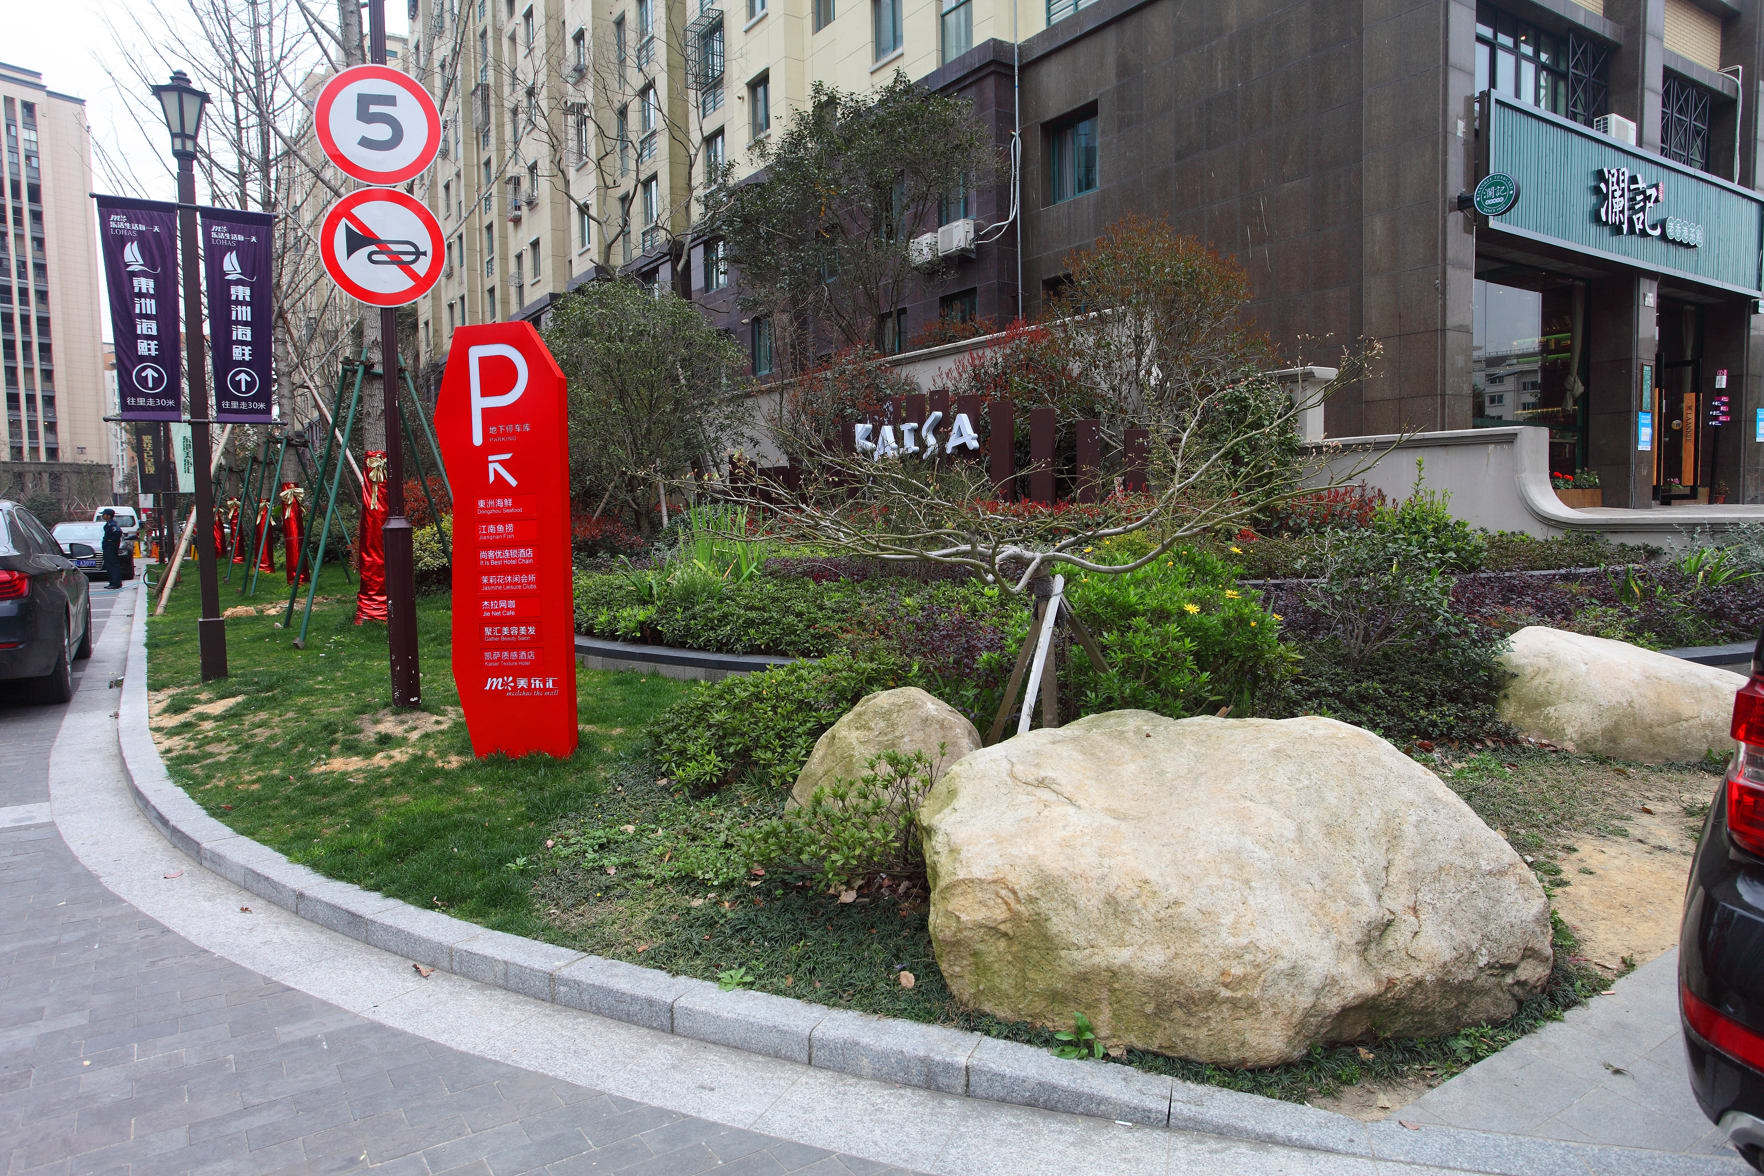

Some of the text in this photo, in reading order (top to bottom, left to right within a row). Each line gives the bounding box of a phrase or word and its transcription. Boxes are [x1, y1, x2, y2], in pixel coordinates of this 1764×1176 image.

[356, 93, 404, 151] 5
[211, 238, 236, 246] LOHAS
[468, 343, 529, 447] P
[127, 396, 175, 407] 往里走30米
[222, 400, 266, 410] 往里走30米
[489, 423, 531, 435] 地下停车库
[479, 548, 533, 559] 尚客优连锁酒店
[481, 574, 536, 584] 茉莉花休闲会所
[482, 600, 516, 609] 杰拉网咖
[484, 626, 536, 636] 聚汇美容美发
[484, 651, 536, 661] 凯萨质感酒店
[516, 677, 559, 689] 美乐汇
